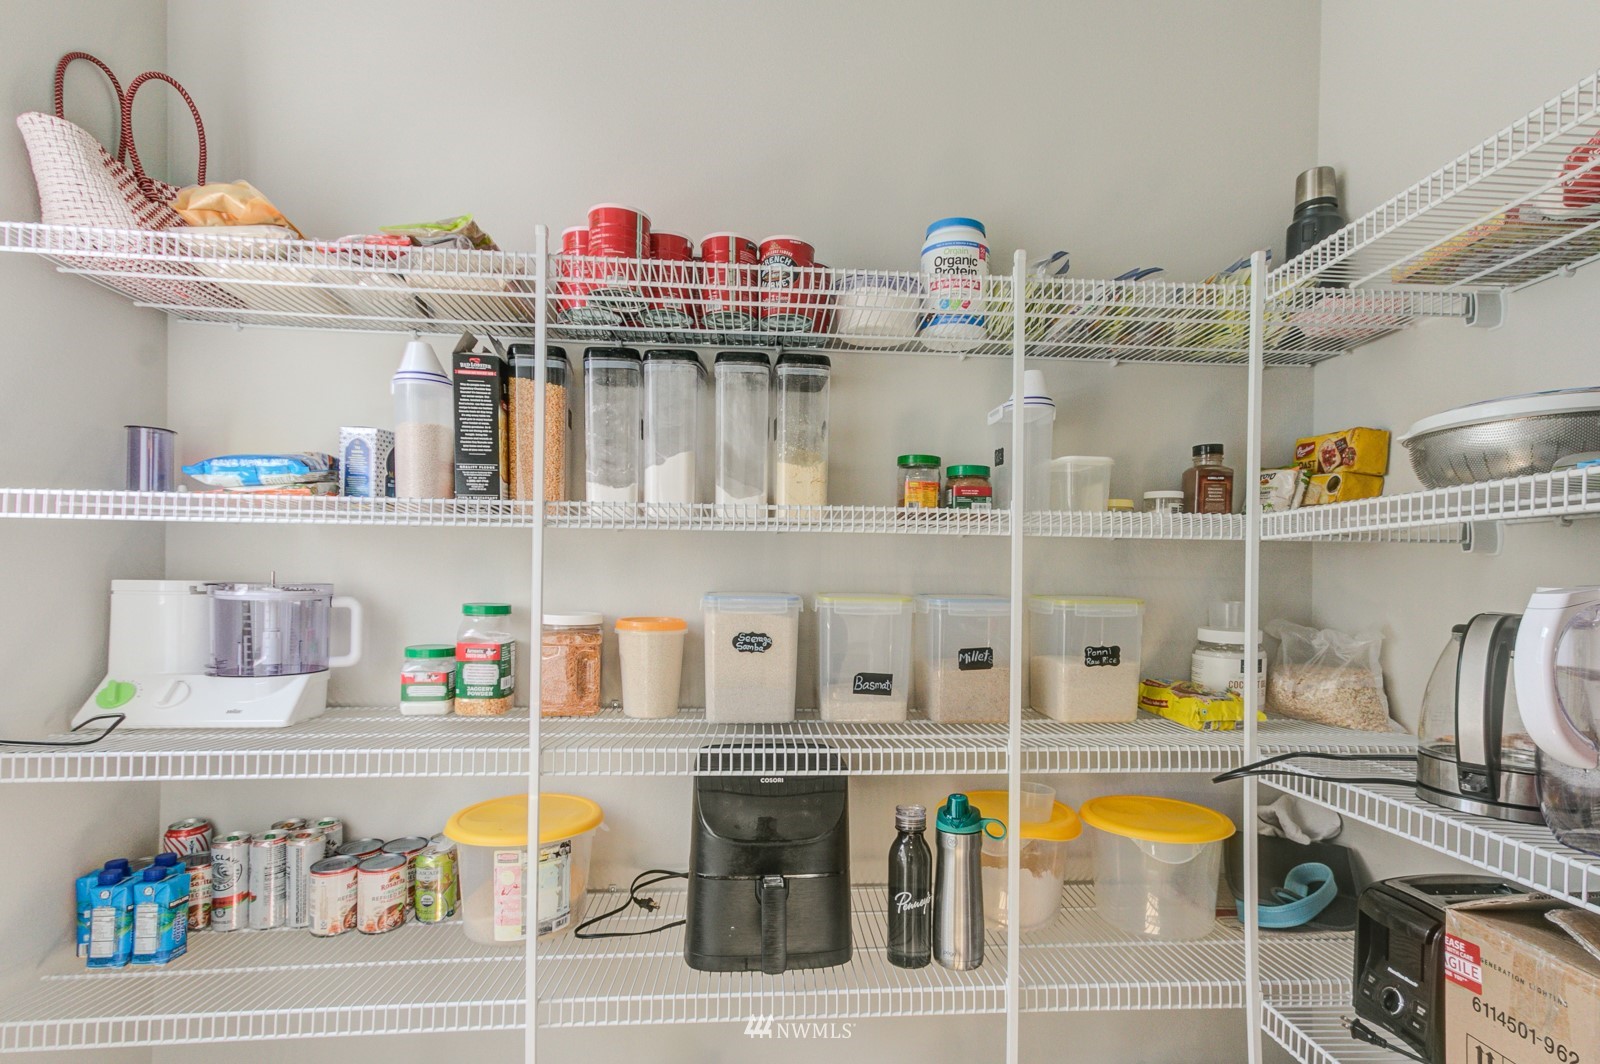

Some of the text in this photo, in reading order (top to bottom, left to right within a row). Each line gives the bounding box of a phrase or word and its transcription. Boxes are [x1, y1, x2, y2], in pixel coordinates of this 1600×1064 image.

[943, 247, 969, 256] Orgain
[934, 254, 978, 268] Organic
[735, 642, 765, 652] Samba
[1086, 647, 1112, 656] Ponni
[958, 650, 994, 664] Millets
[1086, 656, 1117, 665] Raw Rice
[854, 675, 892, 691] Basmati
[1445, 936, 1466, 952] EASE
[1444, 955, 1480, 980] GILE
[1481, 957, 1569, 1009] GENERATION LIGHTING
[1472, 996, 1581, 1064] 6114501-962
